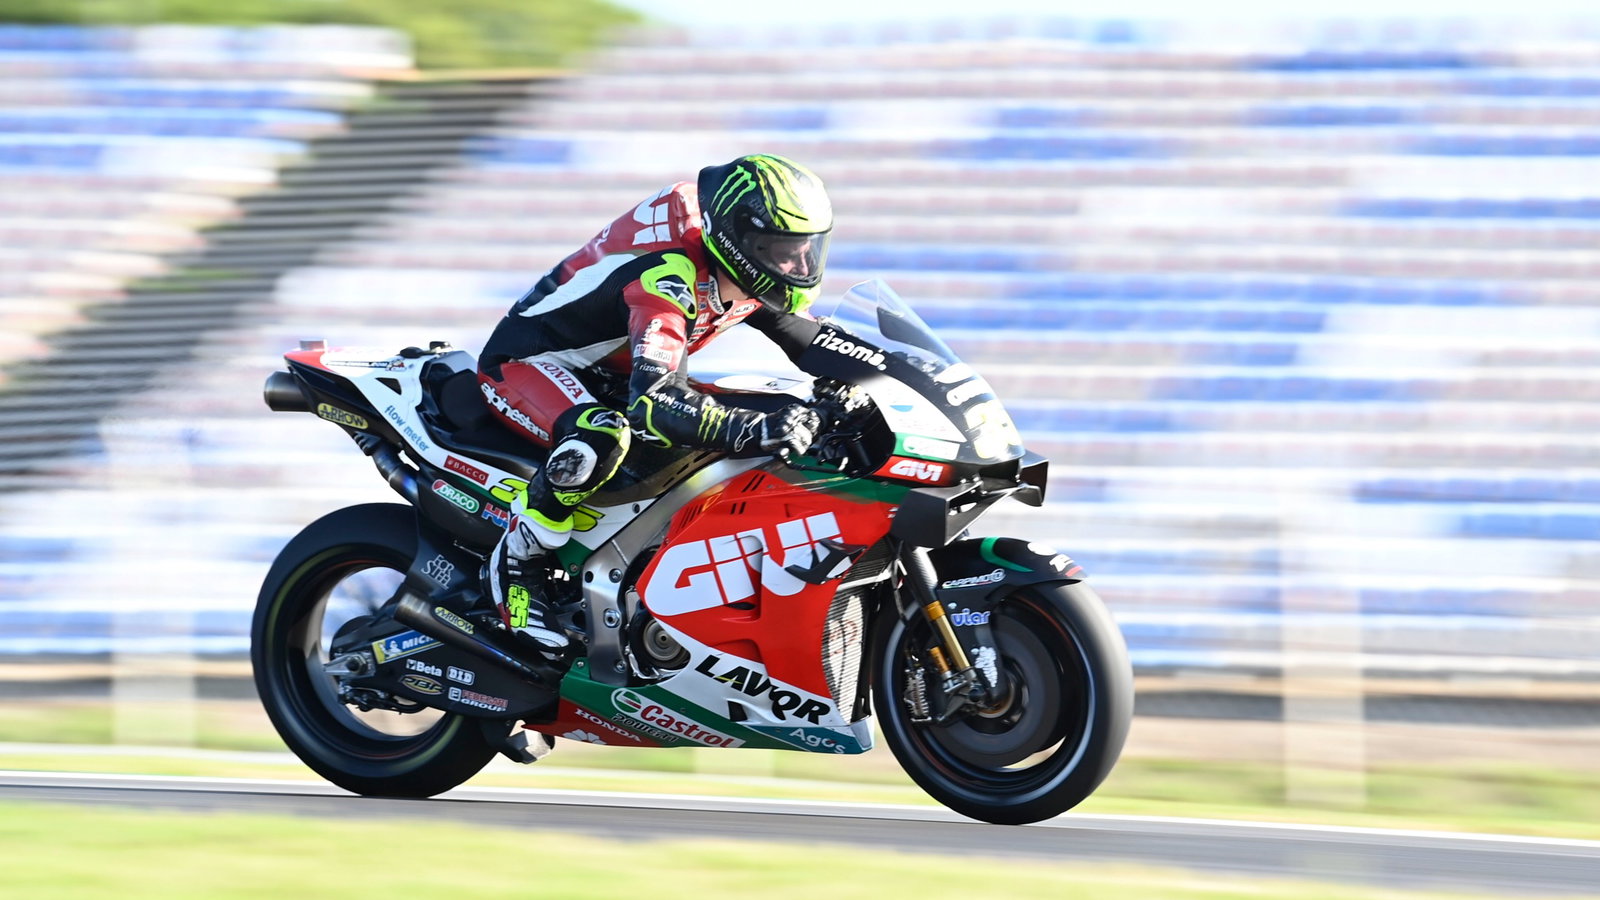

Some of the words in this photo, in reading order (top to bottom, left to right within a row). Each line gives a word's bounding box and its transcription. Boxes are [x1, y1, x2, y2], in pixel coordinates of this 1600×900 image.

[319, 404, 367, 427] ARROW
[480, 382, 550, 442] alpinestars
[384, 405, 406, 428] flow
[402, 424, 430, 452] meter
[453, 461, 487, 481] BACCO
[890, 459, 944, 482] GIVI
[439, 484, 476, 510] DRACO
[645, 511, 848, 616] GIVI
[435, 607, 474, 634] ARROW
[416, 661, 442, 677] Beta
[460, 699, 507, 712] GROUP
[574, 707, 642, 743] HONDA
[640, 704, 735, 748] Castrol
[789, 727, 846, 755] Agos
